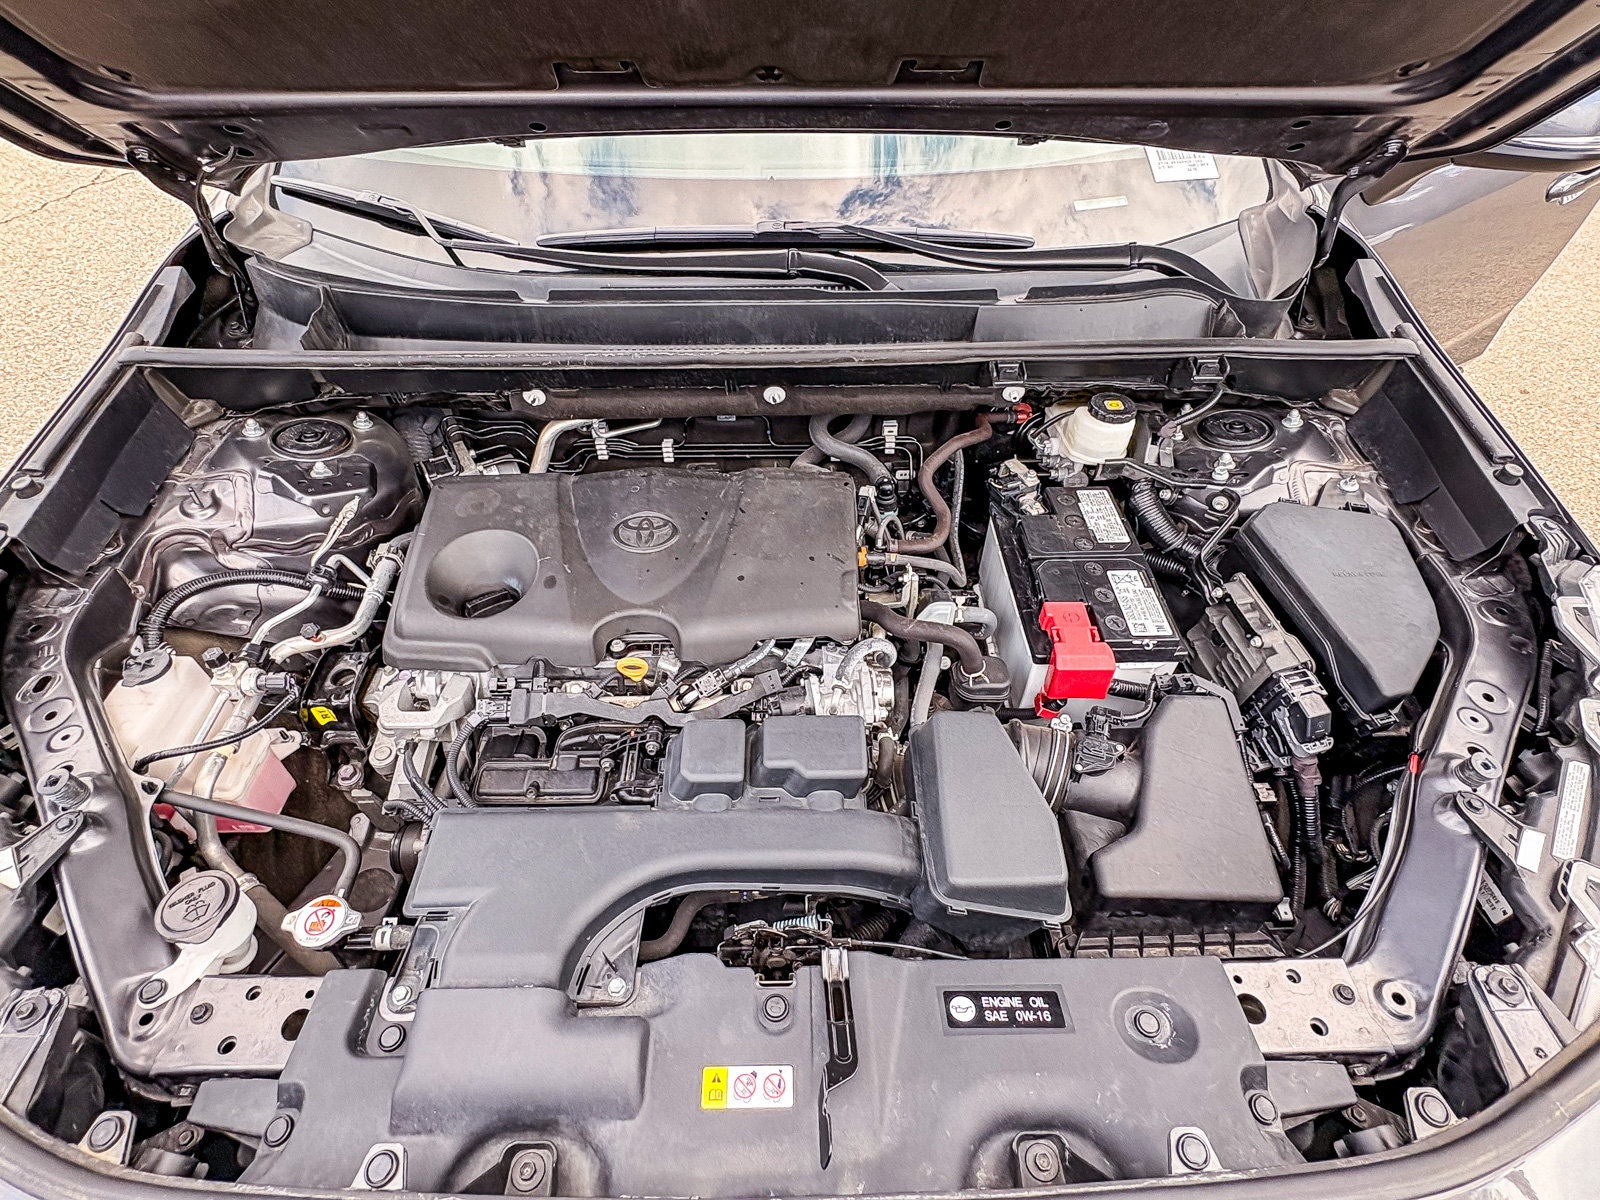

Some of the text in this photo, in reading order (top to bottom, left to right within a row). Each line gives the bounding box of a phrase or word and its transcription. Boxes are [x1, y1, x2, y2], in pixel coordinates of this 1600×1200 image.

[981, 996, 1049, 1008] ENGINE OIL
[984, 1010, 1052, 1022] SAE 0W-16
